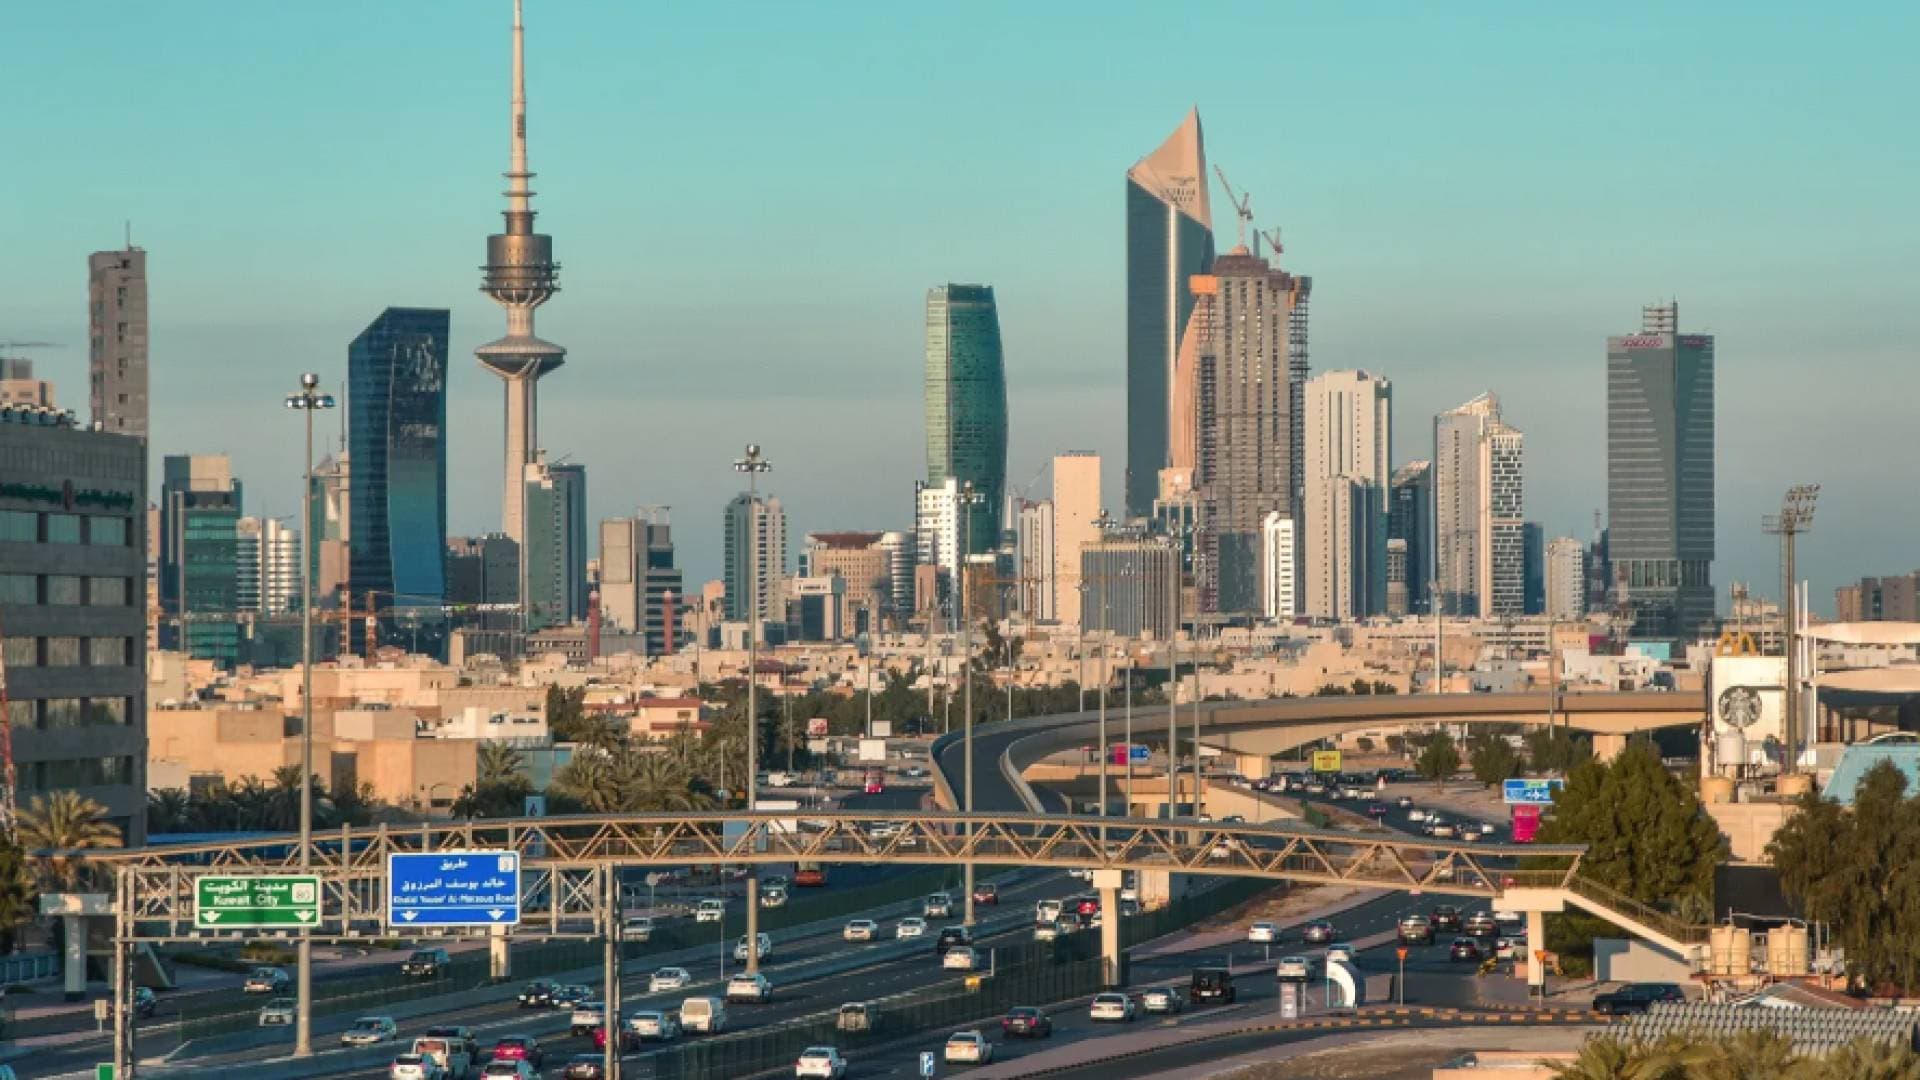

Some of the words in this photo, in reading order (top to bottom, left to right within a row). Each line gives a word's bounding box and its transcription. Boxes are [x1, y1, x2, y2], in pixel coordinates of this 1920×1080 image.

[440, 858, 468, 870] طريق
[204, 880, 248, 894] الكويت
[253, 879, 289, 895] مدينة
[213, 895, 250, 905] Kuwait
[256, 894, 280, 908] City
